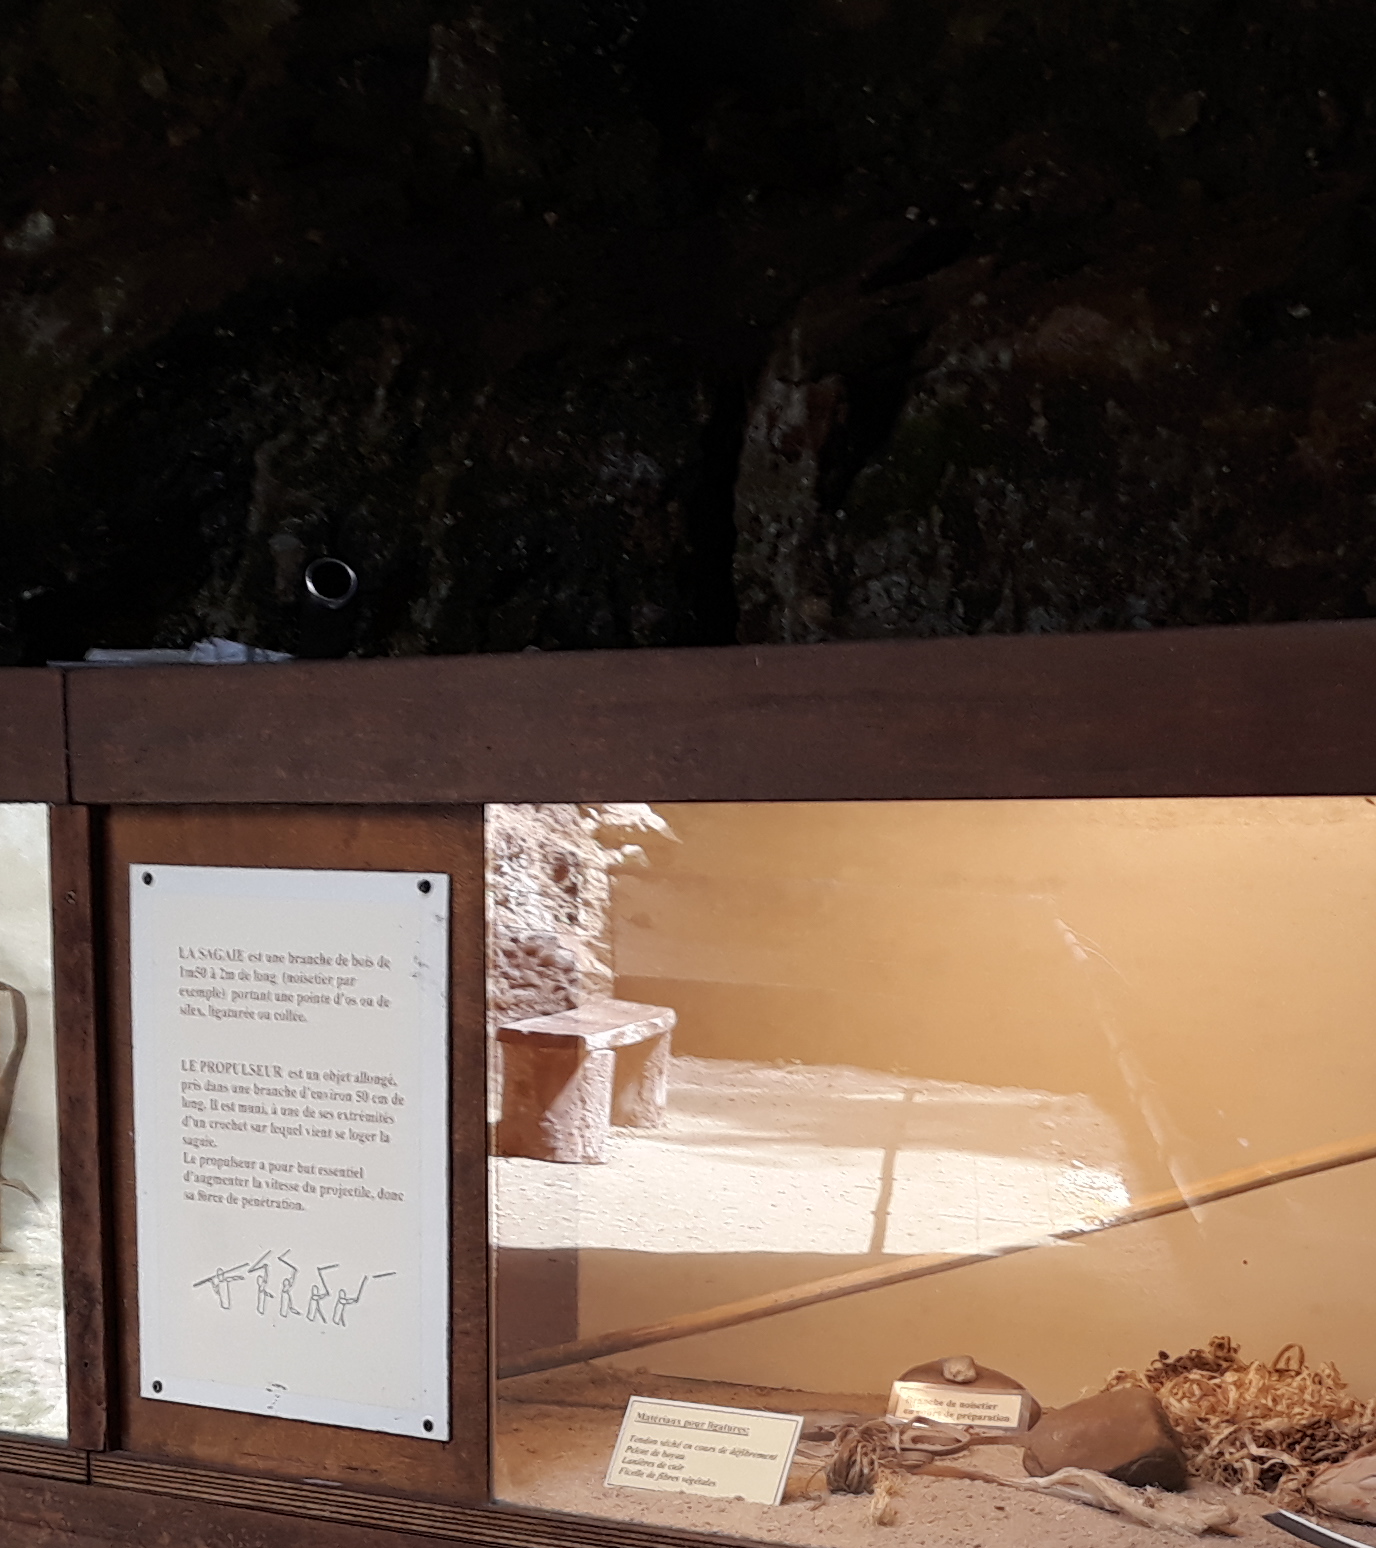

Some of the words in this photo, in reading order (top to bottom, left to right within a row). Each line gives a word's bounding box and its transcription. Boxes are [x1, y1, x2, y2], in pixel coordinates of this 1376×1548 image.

[178, 947, 195, 959] LA
[197, 949, 244, 962] SAGAIE
[248, 952, 262, 962] est
[265, 954, 285, 963] une
[287, 953, 332, 965] branche
[335, 954, 349, 966] de
[351, 954, 375, 968] bois
[377, 956, 392, 969] de
[238, 969, 251, 981] de
[254, 970, 278, 985] long
[336, 977, 357, 989] par
[231, 991, 273, 1002] portant
[275, 993, 294, 1002] une
[297, 992, 330, 1006] pointe
[360, 998, 373, 1007] ou
[377, 995, 392, 1007] de
[258, 1011, 271, 1021] ou
[181, 1060, 199, 1072] LE
[201, 1061, 285, 1077] PROPULSEUR
[288, 1069, 304, 1079] est
[307, 1071, 320, 1081] un
[323, 1070, 352, 1084] objet
[181, 1080, 202, 1093] pris
[204, 1081, 229, 1092] dans
[232, 1085, 251, 1094] une
[253, 1084, 298, 1097] branche
[392, 1092, 406, 1105] de
[221, 1102, 236, 1112] est
[280, 1107, 300, 1117] une
[302, 1106, 316, 1118] de
[209, 1119, 248, 1131] crochet
[250, 1124, 268, 1132] sur
[270, 1123, 303, 1137] lequel
[305, 1126, 333, 1138] vient
[335, 1131, 348, 1139] se
[351, 1129, 377, 1143] loger
[380, 1130, 391, 1143] la
[183, 1152, 197, 1164] Le
[200, 1157, 256, 1169] propulseur
[259, 1162, 266, 1170] a
[269, 1163, 295, 1173] pour
[297, 1162, 315, 1174] but
[318, 1167, 365, 1178] essentiel
[252, 1176, 263, 1188] la
[265, 1179, 300, 1191] vitesse
[302, 1181, 318, 1193] du
[226, 1192, 239, 1204] de
